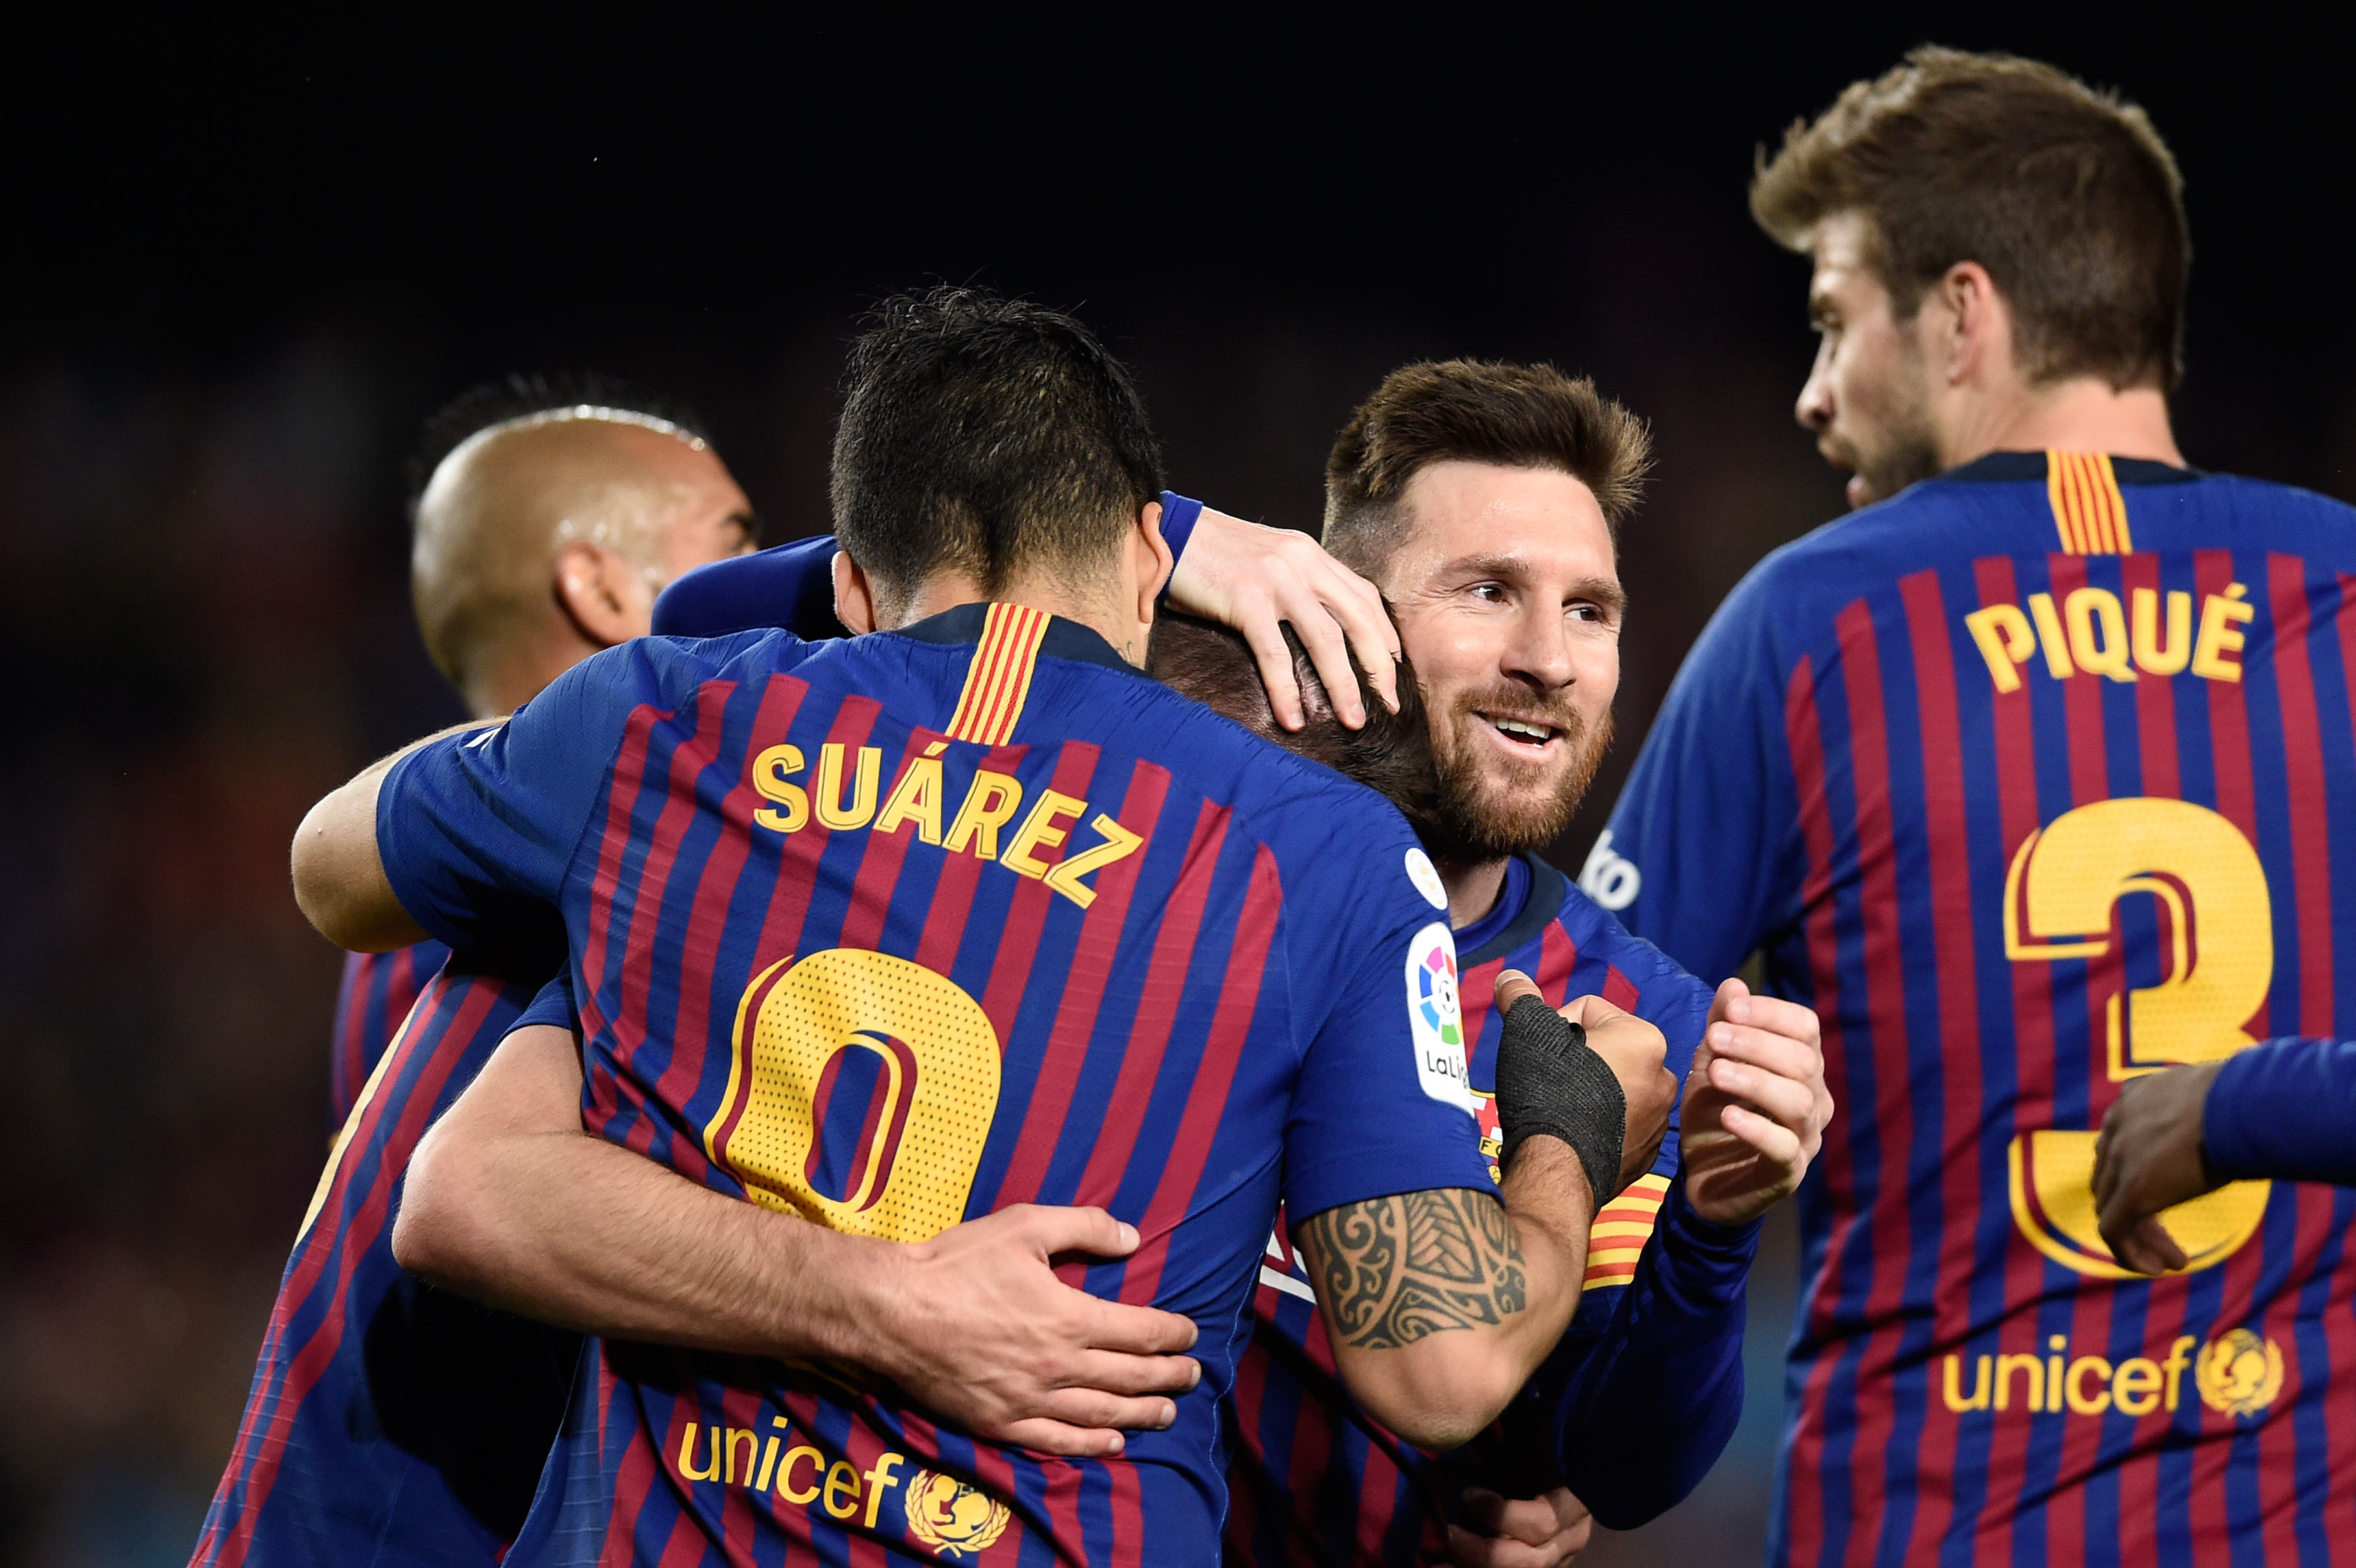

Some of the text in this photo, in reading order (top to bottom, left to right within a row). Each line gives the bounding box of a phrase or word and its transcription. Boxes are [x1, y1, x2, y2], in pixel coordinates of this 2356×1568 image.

[1965, 582, 2255, 693] PIQUÉ
[752, 740, 1144, 909] SUÁREZ
[1576, 828, 1641, 910] ko
[1426, 1050, 1469, 1089] LaLig
[2003, 797, 2274, 1279] 3
[1943, 1334, 2195, 1416] unicef
[677, 1415, 904, 1528] unicef
